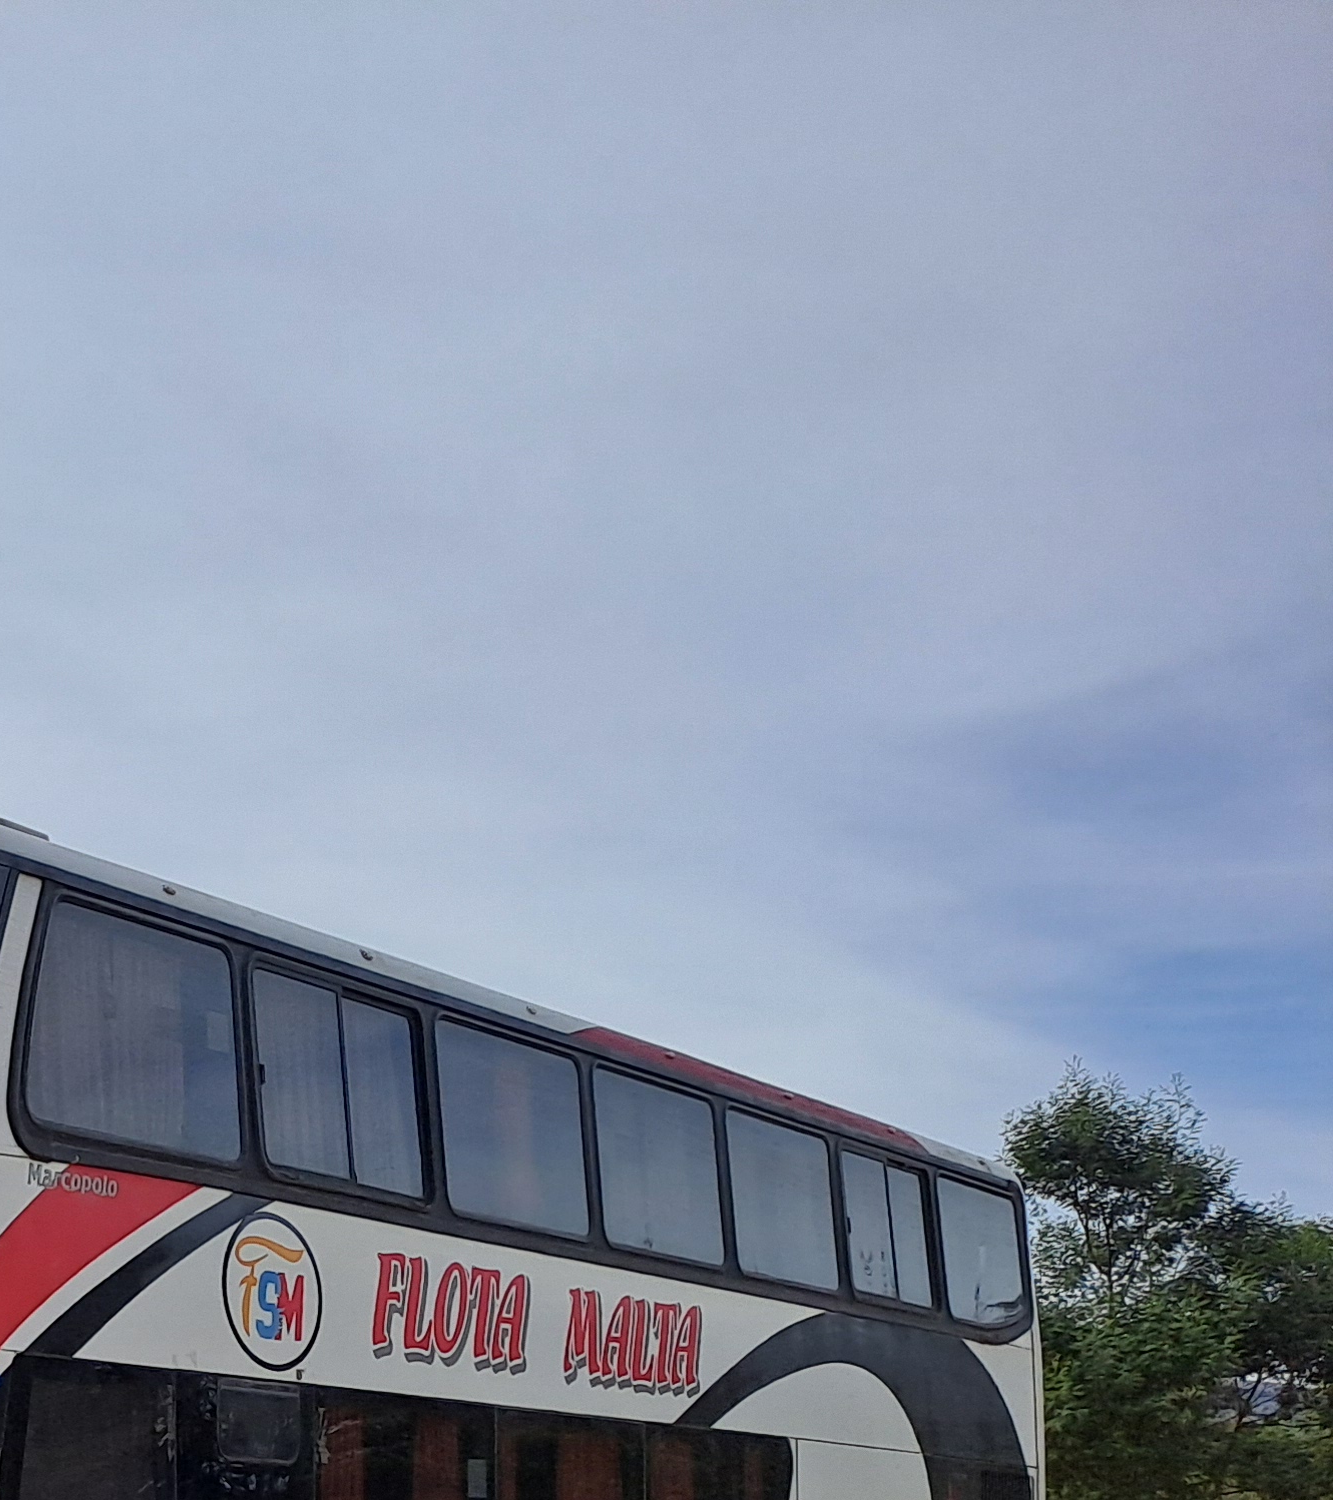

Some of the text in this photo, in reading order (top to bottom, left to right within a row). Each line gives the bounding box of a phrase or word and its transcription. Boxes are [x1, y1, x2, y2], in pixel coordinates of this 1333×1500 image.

[27, 1162, 118, 1198] Marcopolo
[371, 1252, 703, 1398] FLOTA MALTA
